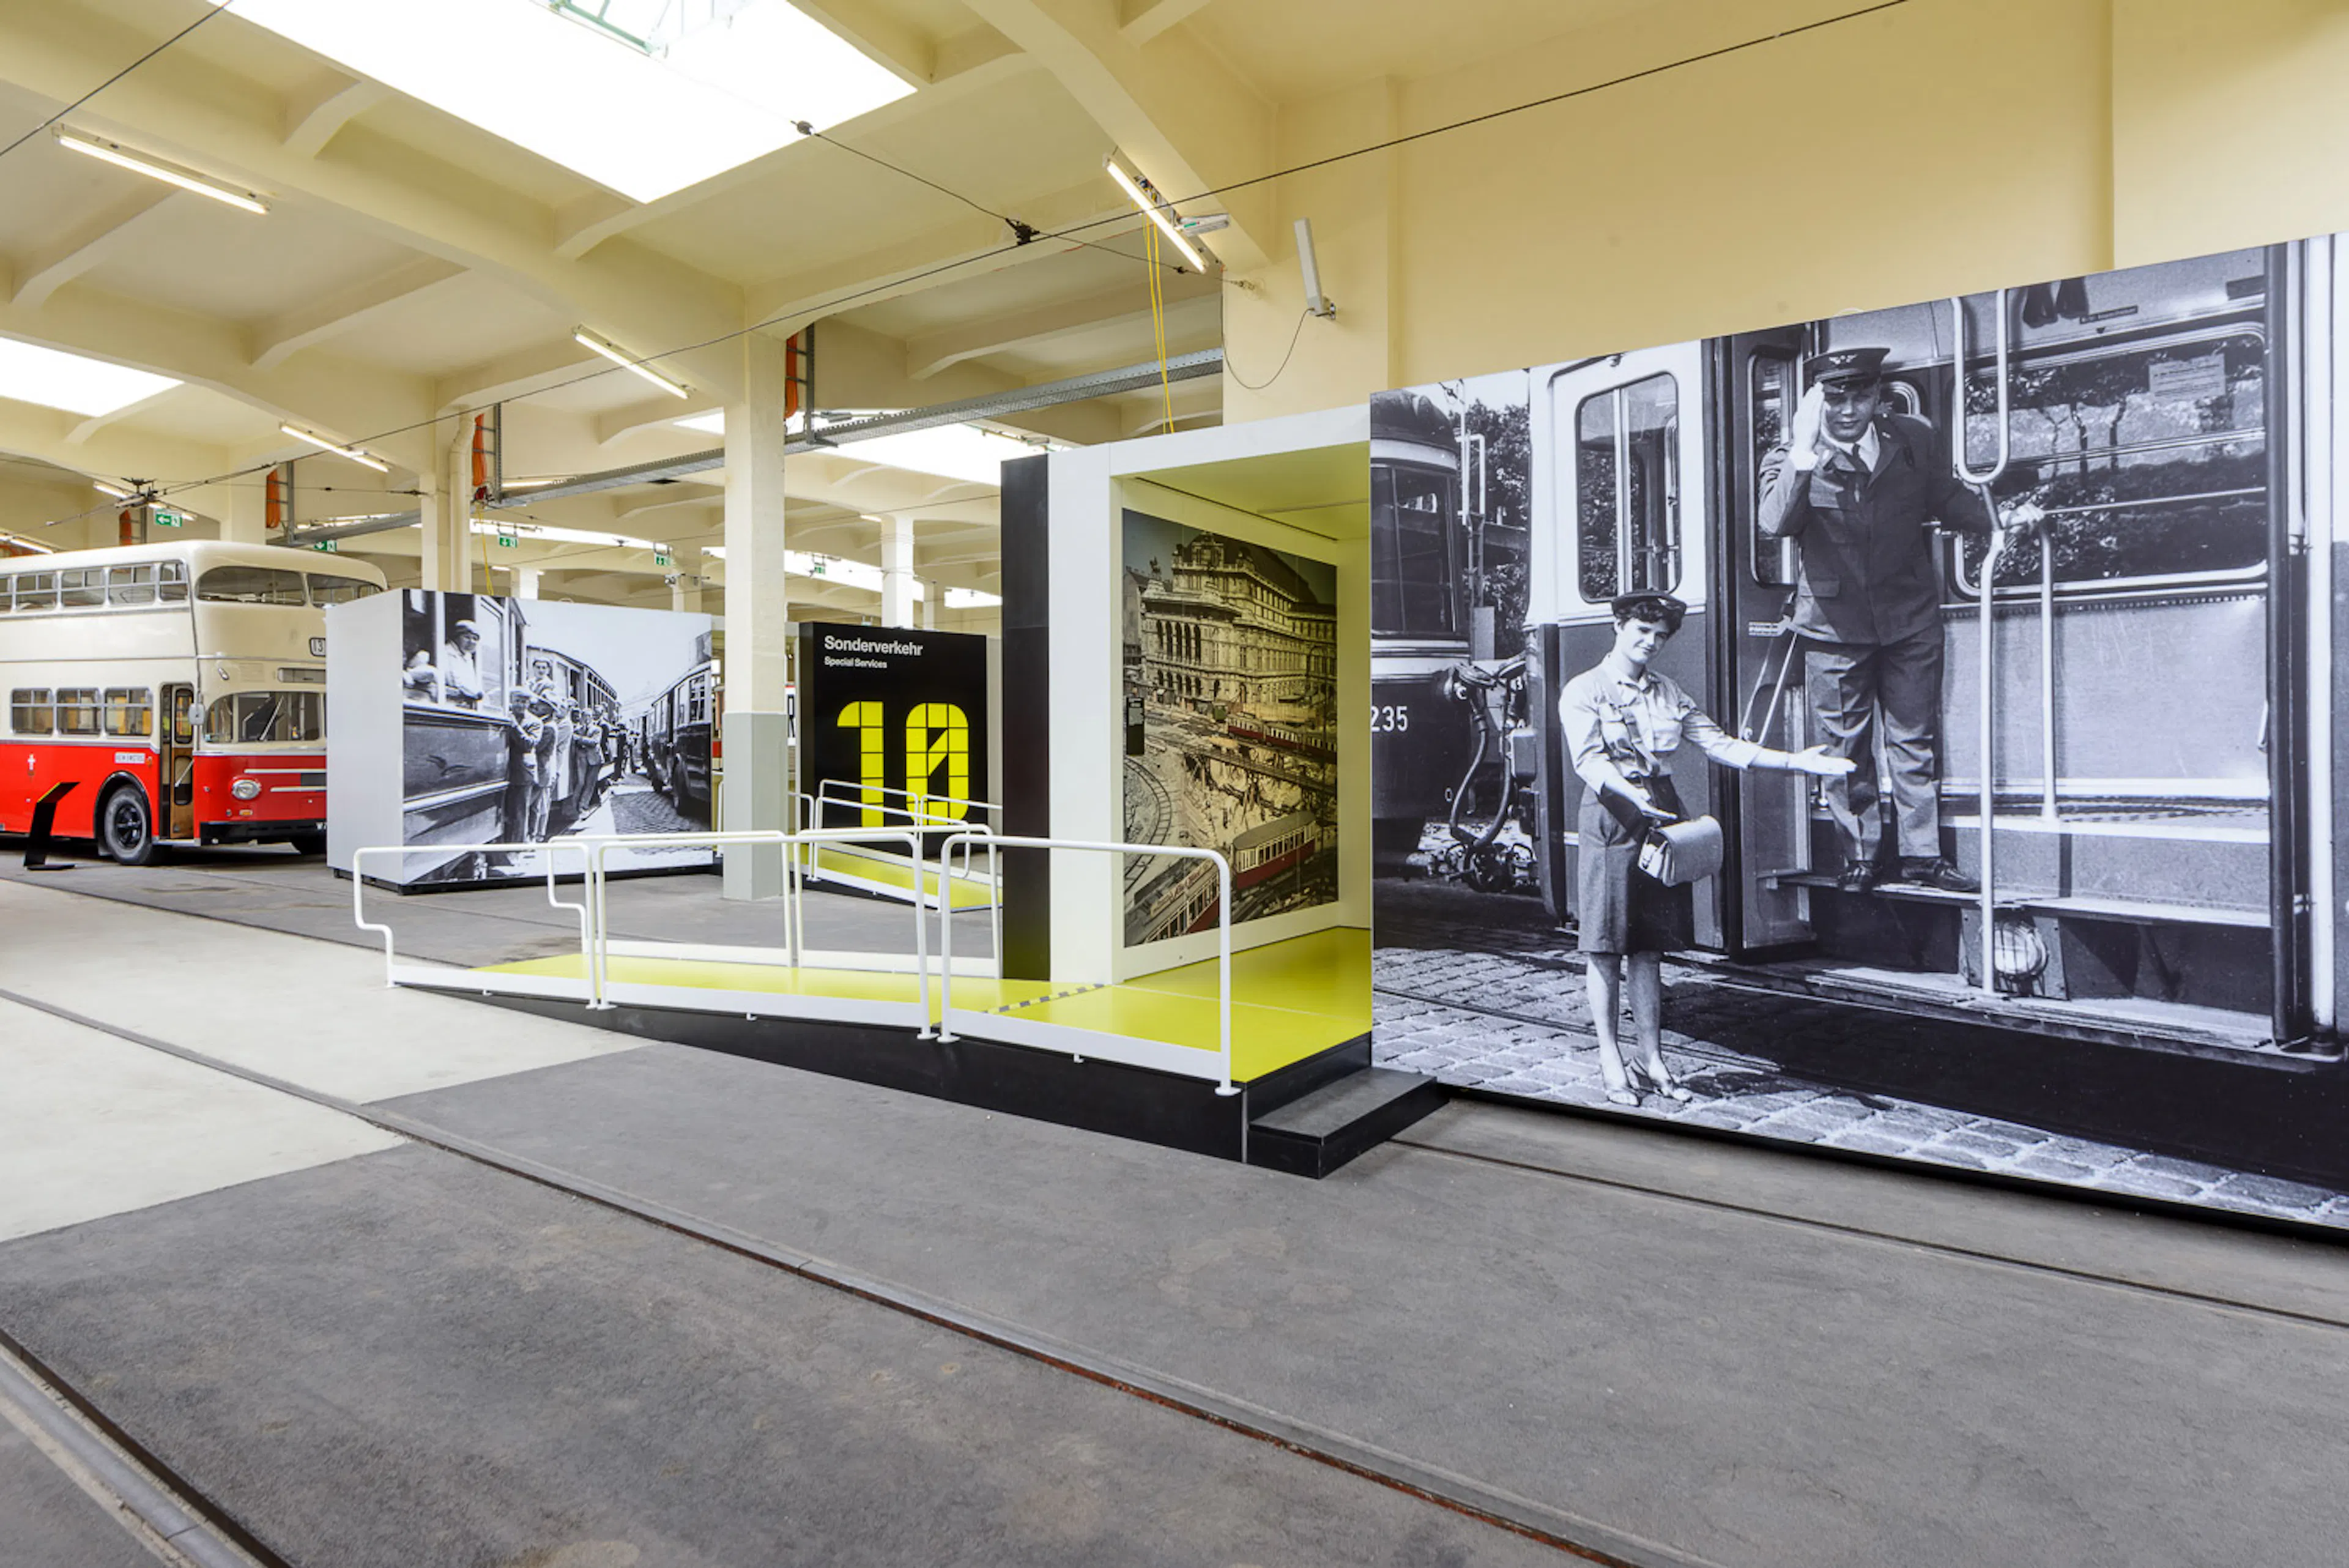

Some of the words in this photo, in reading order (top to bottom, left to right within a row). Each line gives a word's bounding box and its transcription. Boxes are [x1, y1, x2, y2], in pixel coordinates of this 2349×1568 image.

[825, 635, 923, 656] Sonderverkehr
[825, 656, 854, 667] Special
[855, 658, 888, 669] Services
[1371, 705, 1408, 732] 235
[837, 701, 969, 827] 10
